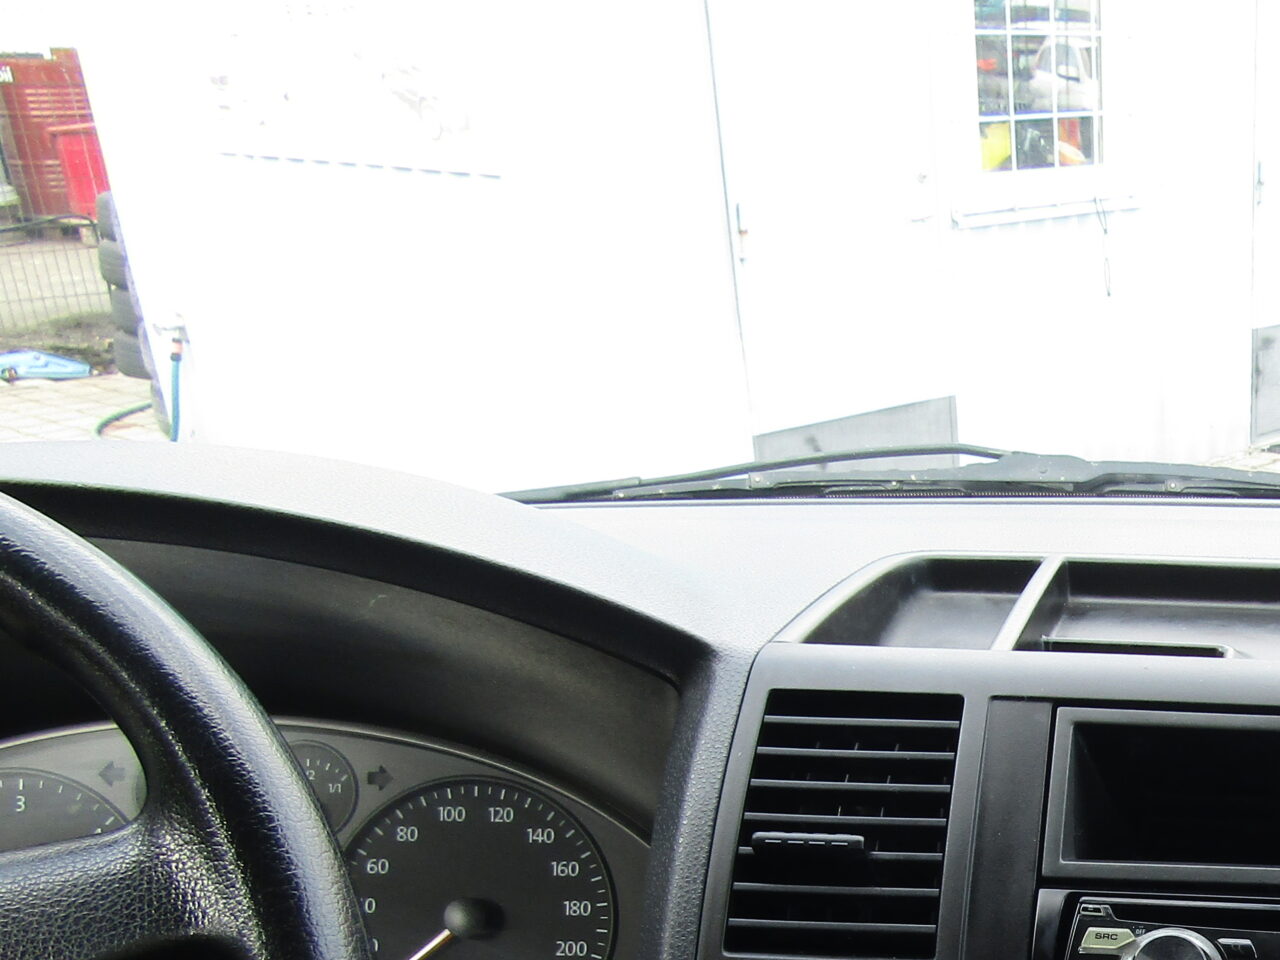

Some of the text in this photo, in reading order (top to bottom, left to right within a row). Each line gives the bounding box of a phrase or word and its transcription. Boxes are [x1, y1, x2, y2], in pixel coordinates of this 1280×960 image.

[15, 795, 26, 812] 3
[437, 806, 467, 822] 100
[488, 807, 514, 823] 120
[396, 826, 418, 842] 80
[527, 828, 555, 844] 140
[366, 858, 389, 874] 60
[551, 861, 579, 877] 160
[563, 900, 591, 917] 180
[1094, 932, 1119, 941] SRC
[555, 941, 588, 957] 200
